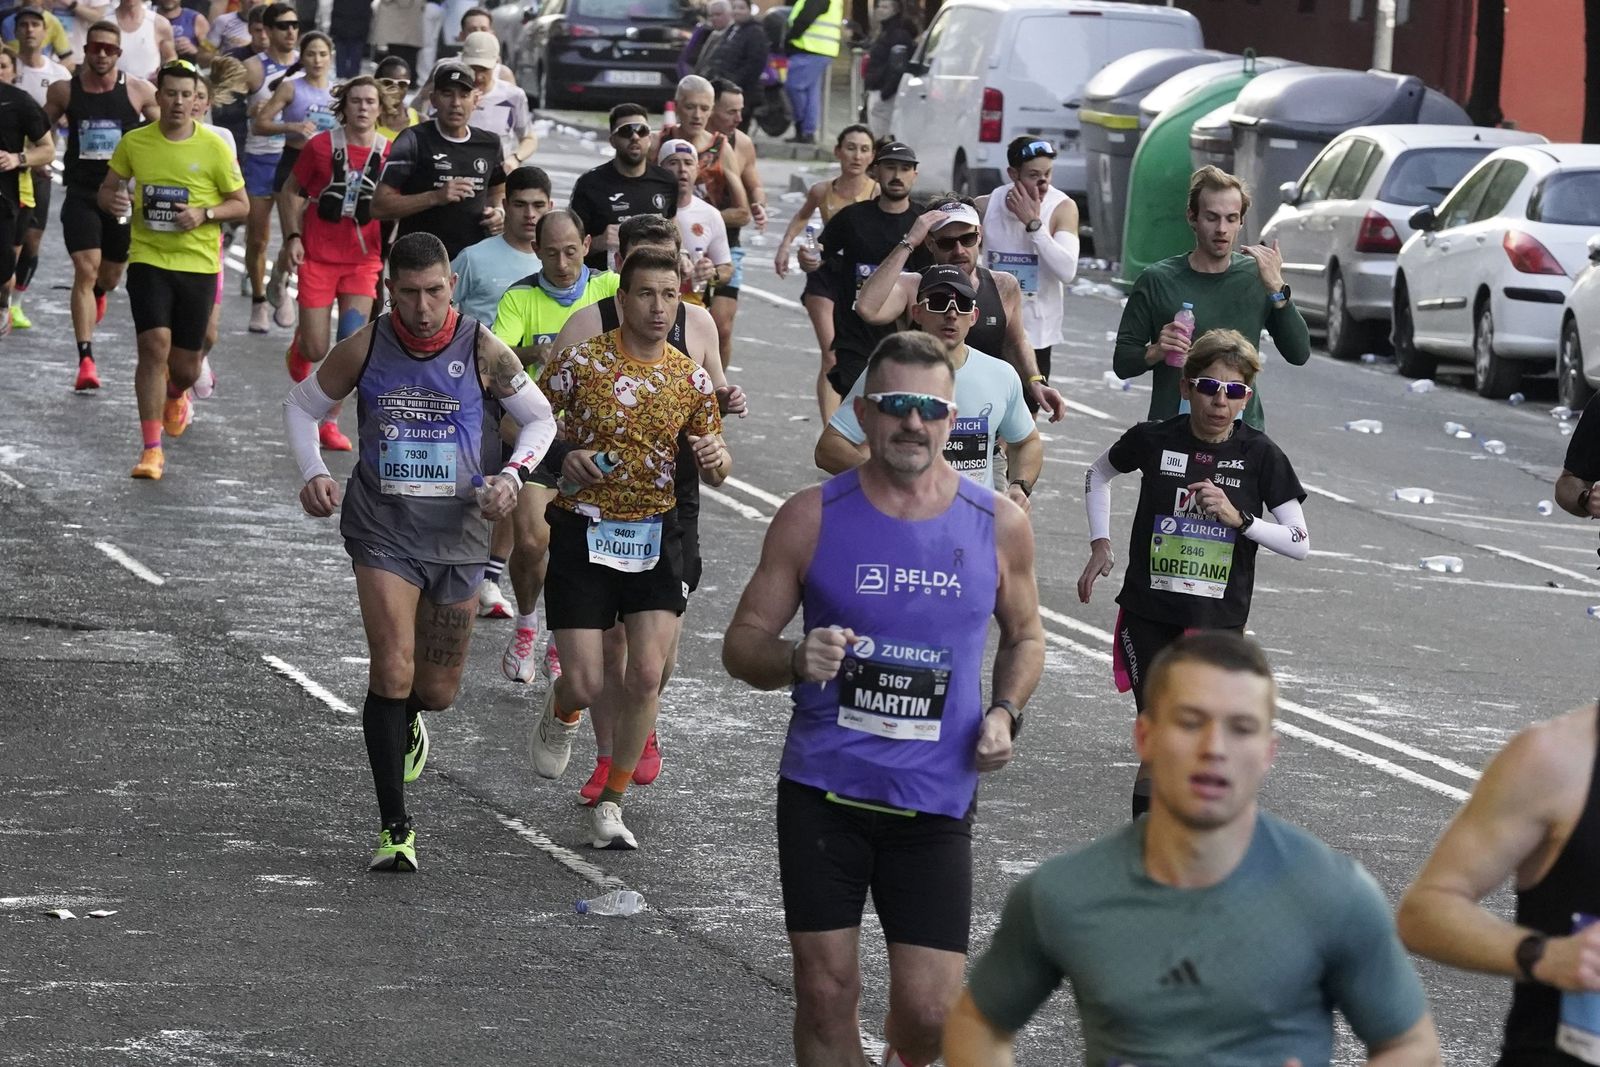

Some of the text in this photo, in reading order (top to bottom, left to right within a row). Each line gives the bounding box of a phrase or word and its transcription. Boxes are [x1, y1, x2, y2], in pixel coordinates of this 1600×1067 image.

[156, 188, 184, 197] ZURICH
[1002, 255, 1033, 264] ZURICH
[408, 400, 429, 408] PUENTE
[429, 401, 440, 410] DEL
[440, 402, 460, 411] CANTO
[391, 410, 446, 422] SORIA
[950, 421, 981, 431] URICH
[404, 428, 447, 439] ZURICH
[404, 449, 428, 460] 7930
[949, 459, 987, 470] ANCISCO
[1166, 456, 1183, 468] JBL
[384, 462, 450, 479] DESIUNAI
[1173, 510, 1186, 518] DON
[1186, 512, 1204, 520] KENYA
[614, 528, 635, 538] 9403
[1181, 522, 1227, 538] ZURICH
[595, 538, 652, 556] PAQUITO
[1180, 544, 1205, 557] 2846
[1152, 556, 1227, 581] LOREDANA
[895, 568, 961, 589] BELDA
[894, 585, 961, 598] SPORT
[881, 644, 941, 663] ZURICH
[878, 673, 912, 690] 5167
[854, 687, 931, 717] MARTIN
